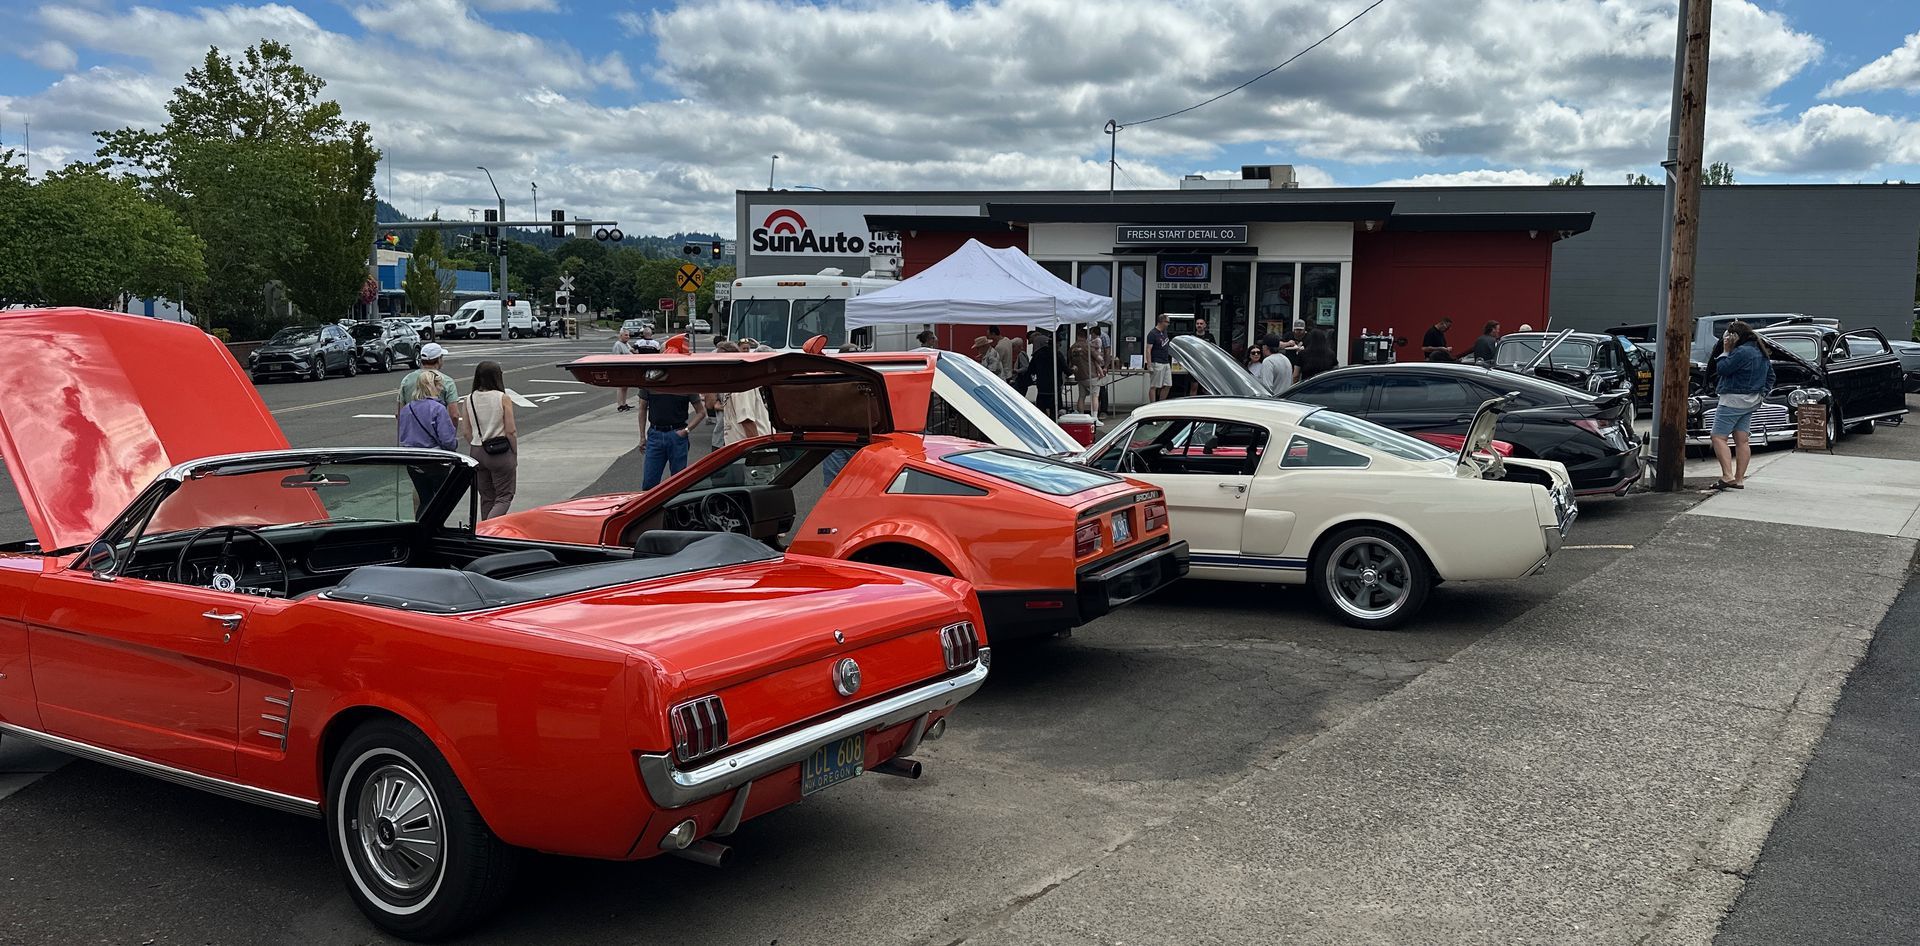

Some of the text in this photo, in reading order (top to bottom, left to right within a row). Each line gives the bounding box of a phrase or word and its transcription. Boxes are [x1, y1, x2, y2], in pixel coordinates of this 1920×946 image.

[753, 228, 864, 253] SunAuto
[1127, 230, 1236, 239] FRESH START DETAIL CO.
[868, 241, 902, 254] Servi
[695, 274, 702, 282] R
[1167, 266, 1203, 277] OPEN
[807, 735, 862, 779] LCL 608
[817, 766, 851, 786] OREGON
